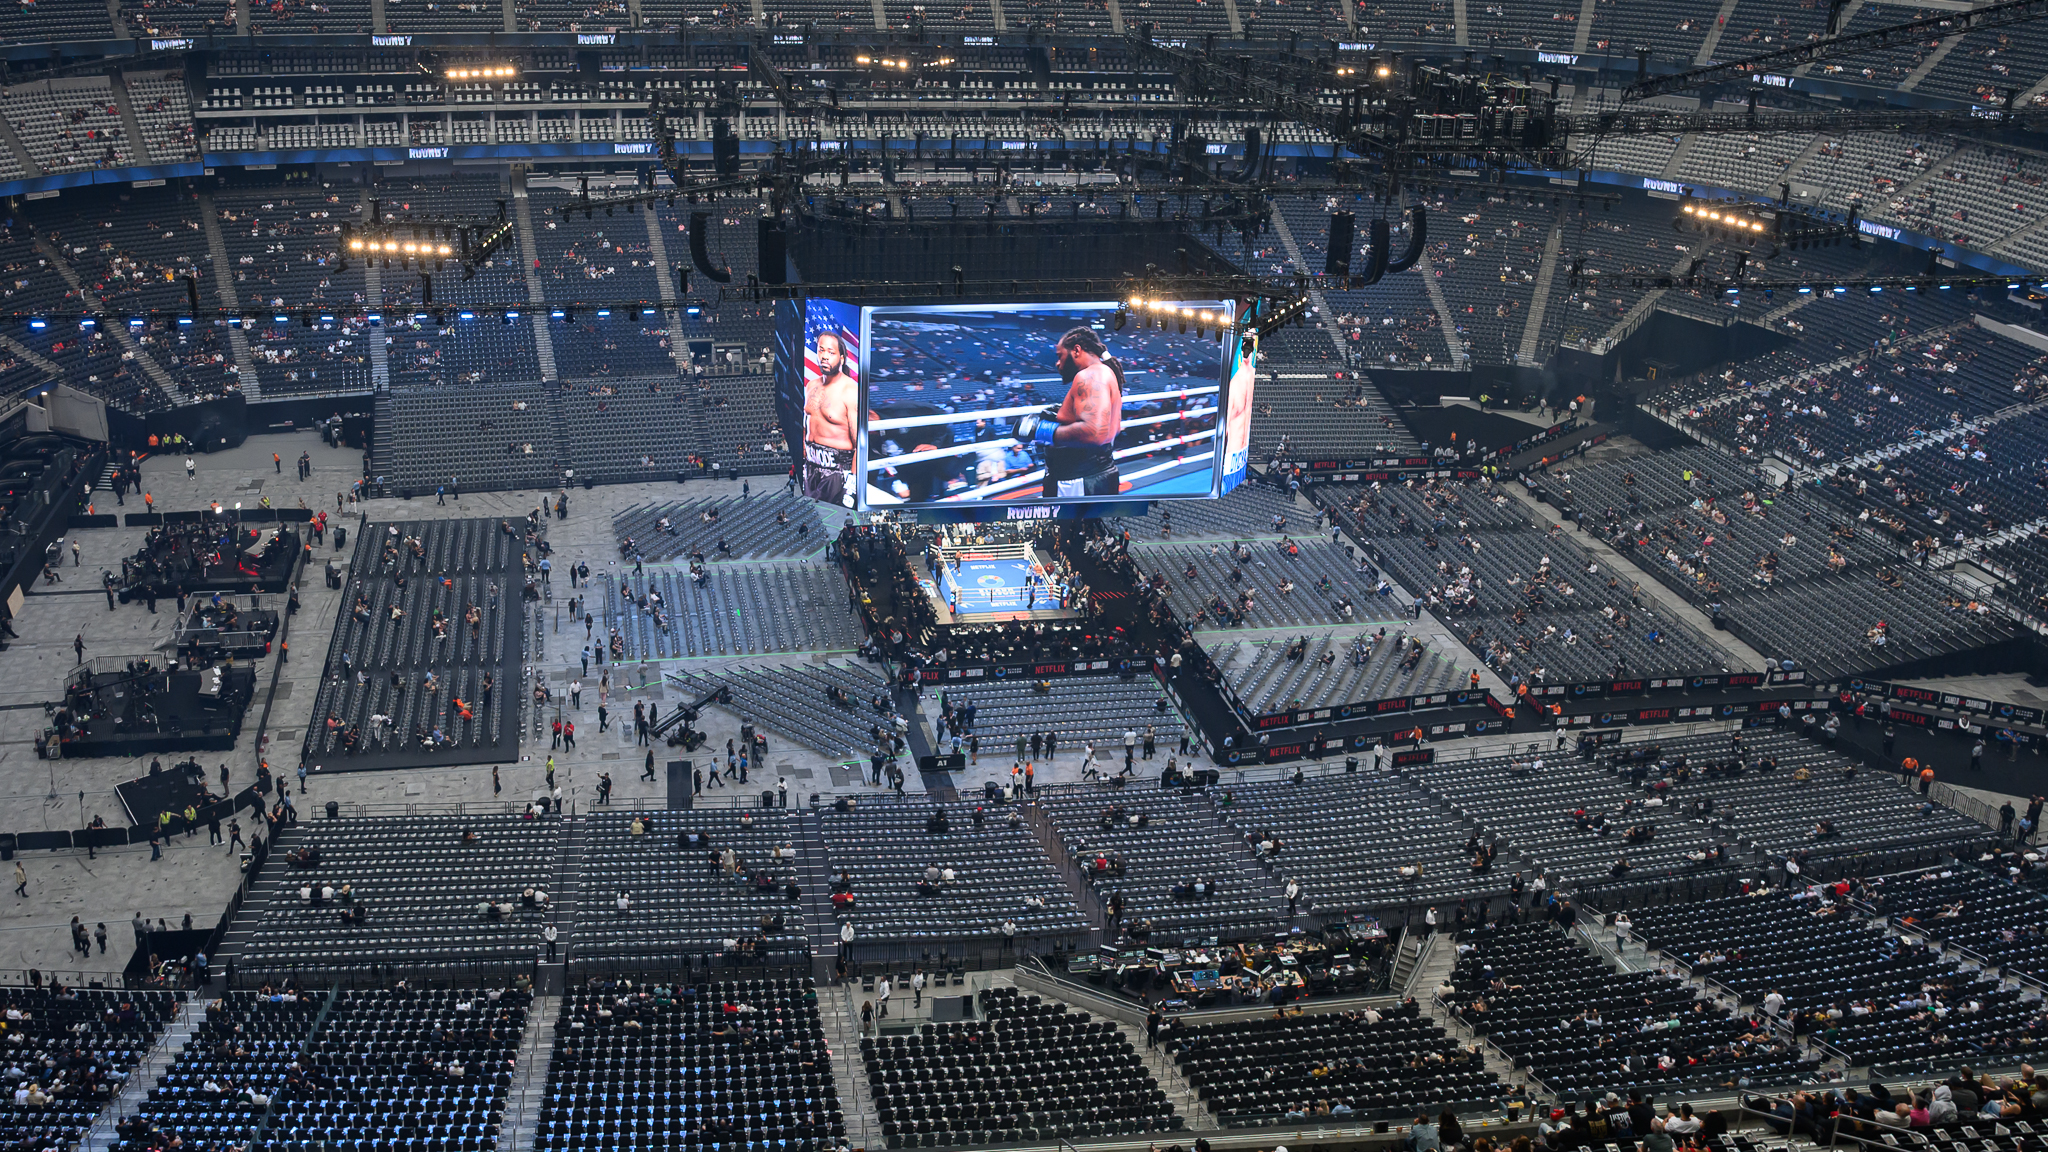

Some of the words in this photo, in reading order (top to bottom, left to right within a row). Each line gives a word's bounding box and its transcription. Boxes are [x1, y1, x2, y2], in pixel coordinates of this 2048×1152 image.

[372, 36, 404, 46] ROUND
[578, 34, 608, 45] ROUND
[1538, 52, 1570, 64] ROUND
[409, 148, 441, 158] ROUND
[614, 144, 645, 154] ROUND
[1643, 178, 1678, 193] ROUND
[1859, 220, 1893, 238] ROUND
[1007, 506, 1050, 520] ROUND
[1051, 506, 1060, 518] 7
[1035, 664, 1065, 674] NETFLIX
[908, 672, 938, 681] NFLIX
[1612, 682, 1642, 692] NETFLIX
[1897, 688, 1934, 701] NETFLIX
[1378, 700, 1406, 711] NETFLIX
[1640, 709, 1669, 720] NETFLIX
[1890, 709, 1926, 725] NETFLIX
[1260, 716, 1289, 727] NETFLIX
[1270, 746, 1300, 757] NETFLIX
